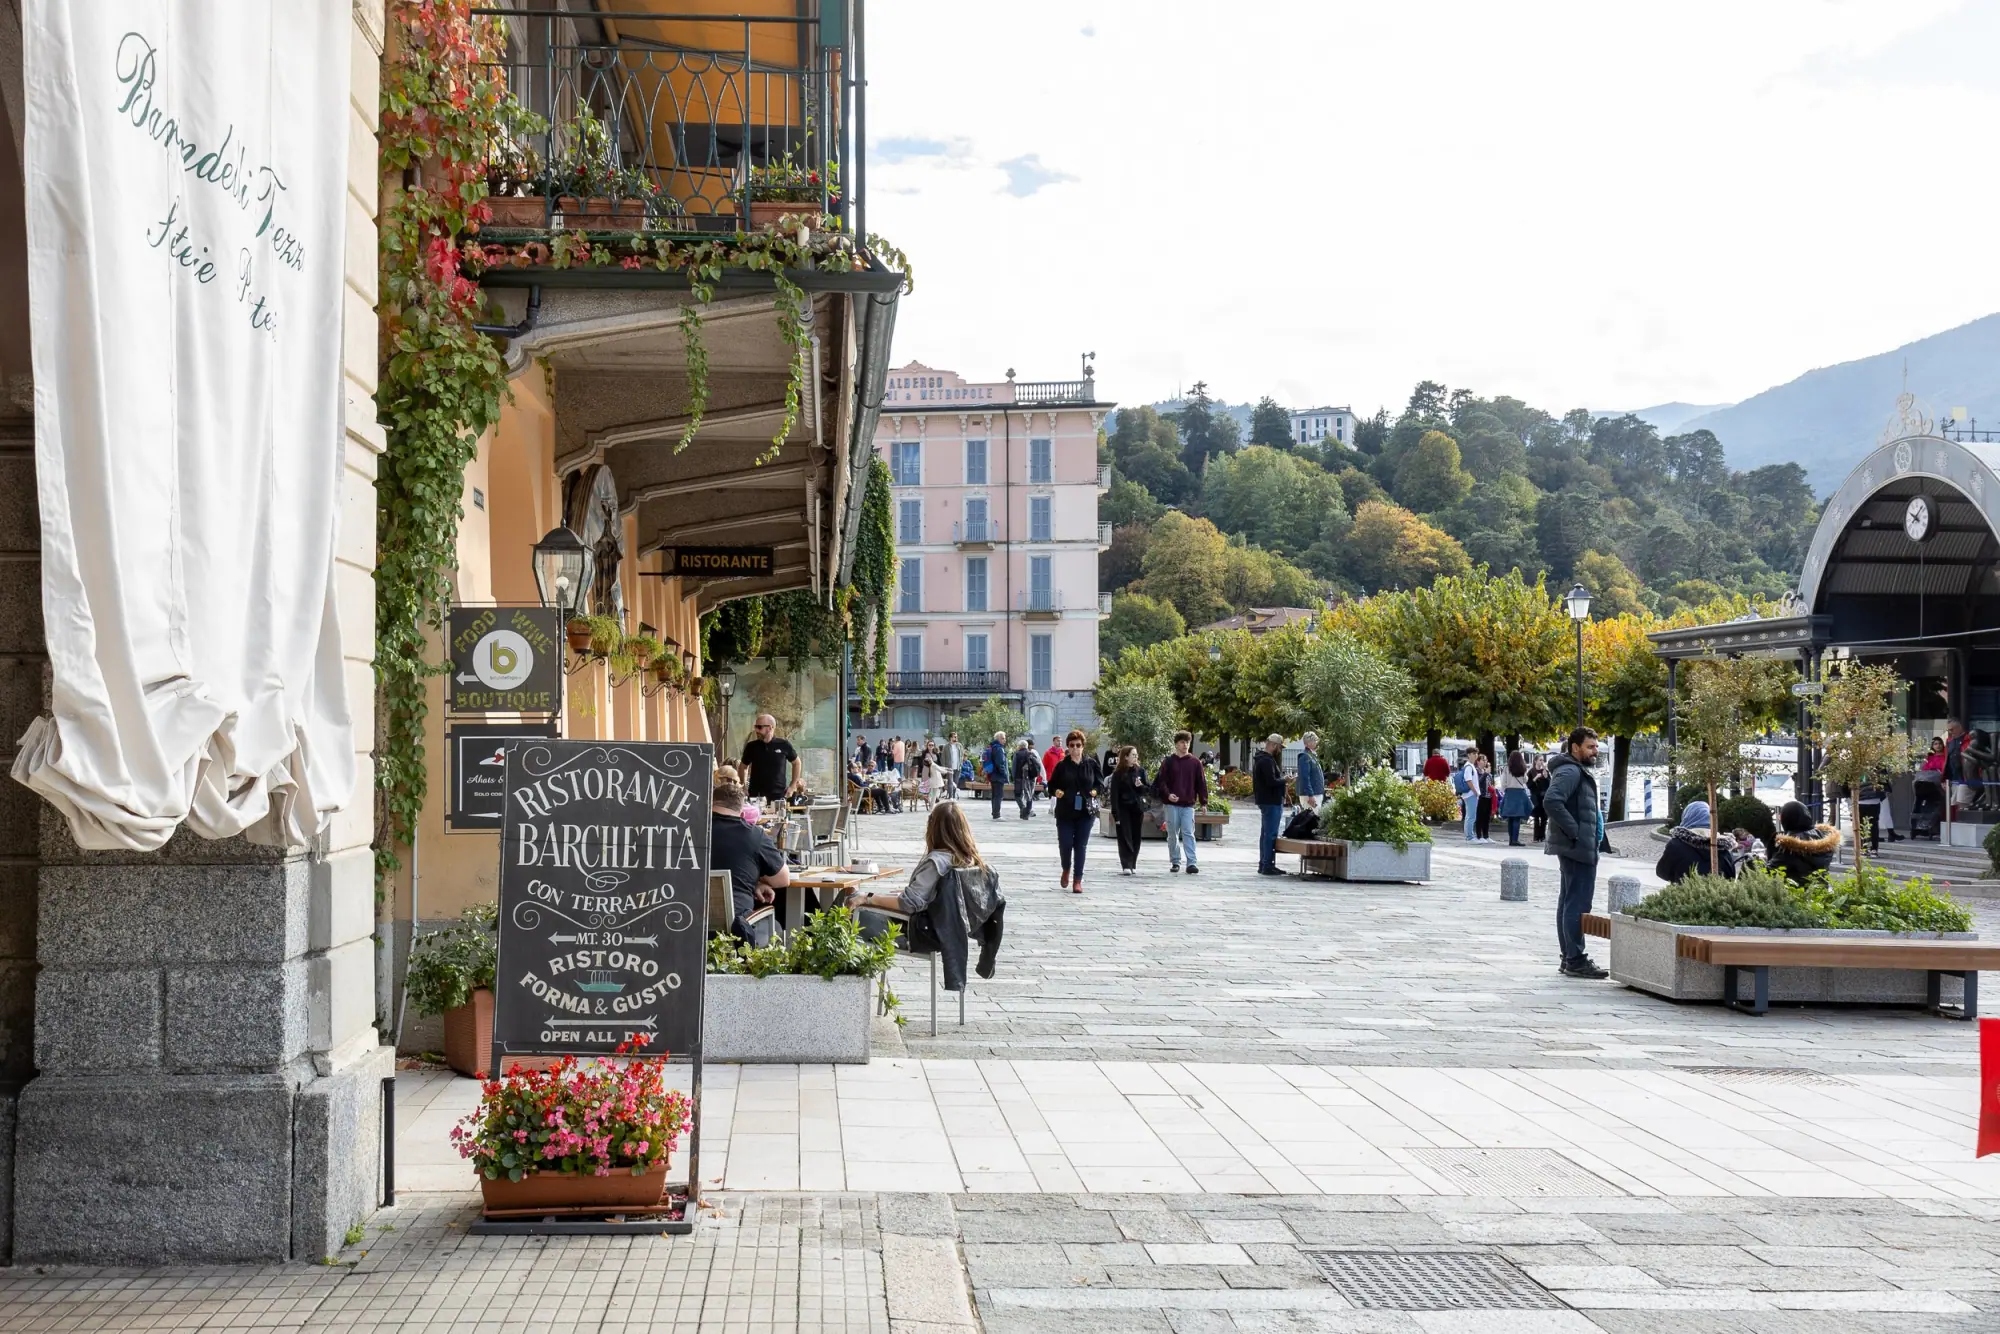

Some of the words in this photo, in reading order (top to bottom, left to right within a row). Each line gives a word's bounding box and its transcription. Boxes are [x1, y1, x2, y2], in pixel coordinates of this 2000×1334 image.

[889, 377, 943, 389] ALBERGO
[921, 388, 993, 400] METROPOLE
[681, 555, 768, 568] RISTORANTE
[454, 610, 497, 653] FOOD
[511, 609, 553, 655] WINE
[456, 691, 551, 711] BOUTIQUE
[512, 767, 700, 823] RISTORANTE
[516, 822, 701, 880] BARCHETTA
[527, 878, 563, 905] CON
[571, 882, 676, 915] TERRAZZO
[575, 932, 599, 946] MT.
[601, 931, 624, 946] 30
[548, 950, 659, 977] RISTORO
[519, 971, 591, 1015] FORMA
[594, 998, 609, 1015] &
[613, 971, 683, 1014] GUSTO
[540, 1030, 580, 1043] OPEN
[585, 1030, 617, 1043] ALL
